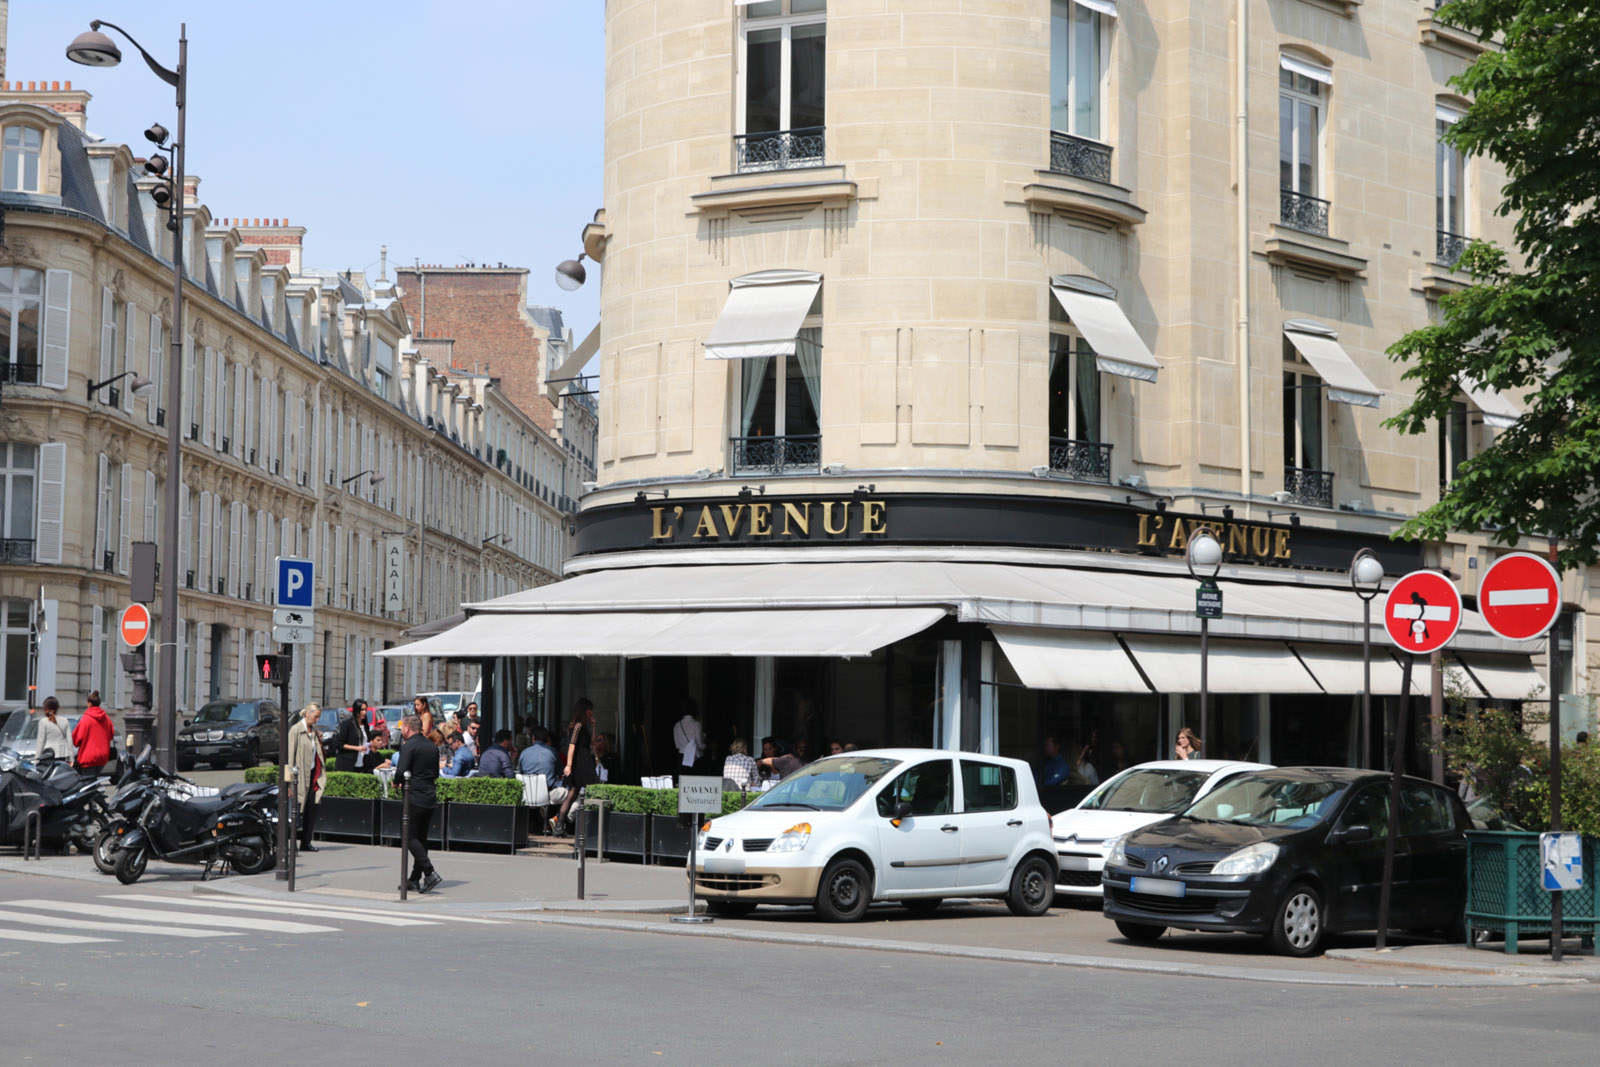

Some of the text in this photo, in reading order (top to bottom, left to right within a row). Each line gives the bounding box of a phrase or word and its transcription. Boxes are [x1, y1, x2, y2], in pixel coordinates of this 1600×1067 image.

[650, 500, 887, 539] L'AVENUE
[287, 568, 304, 598] P
[683, 786, 720, 794] L'AVENUE
